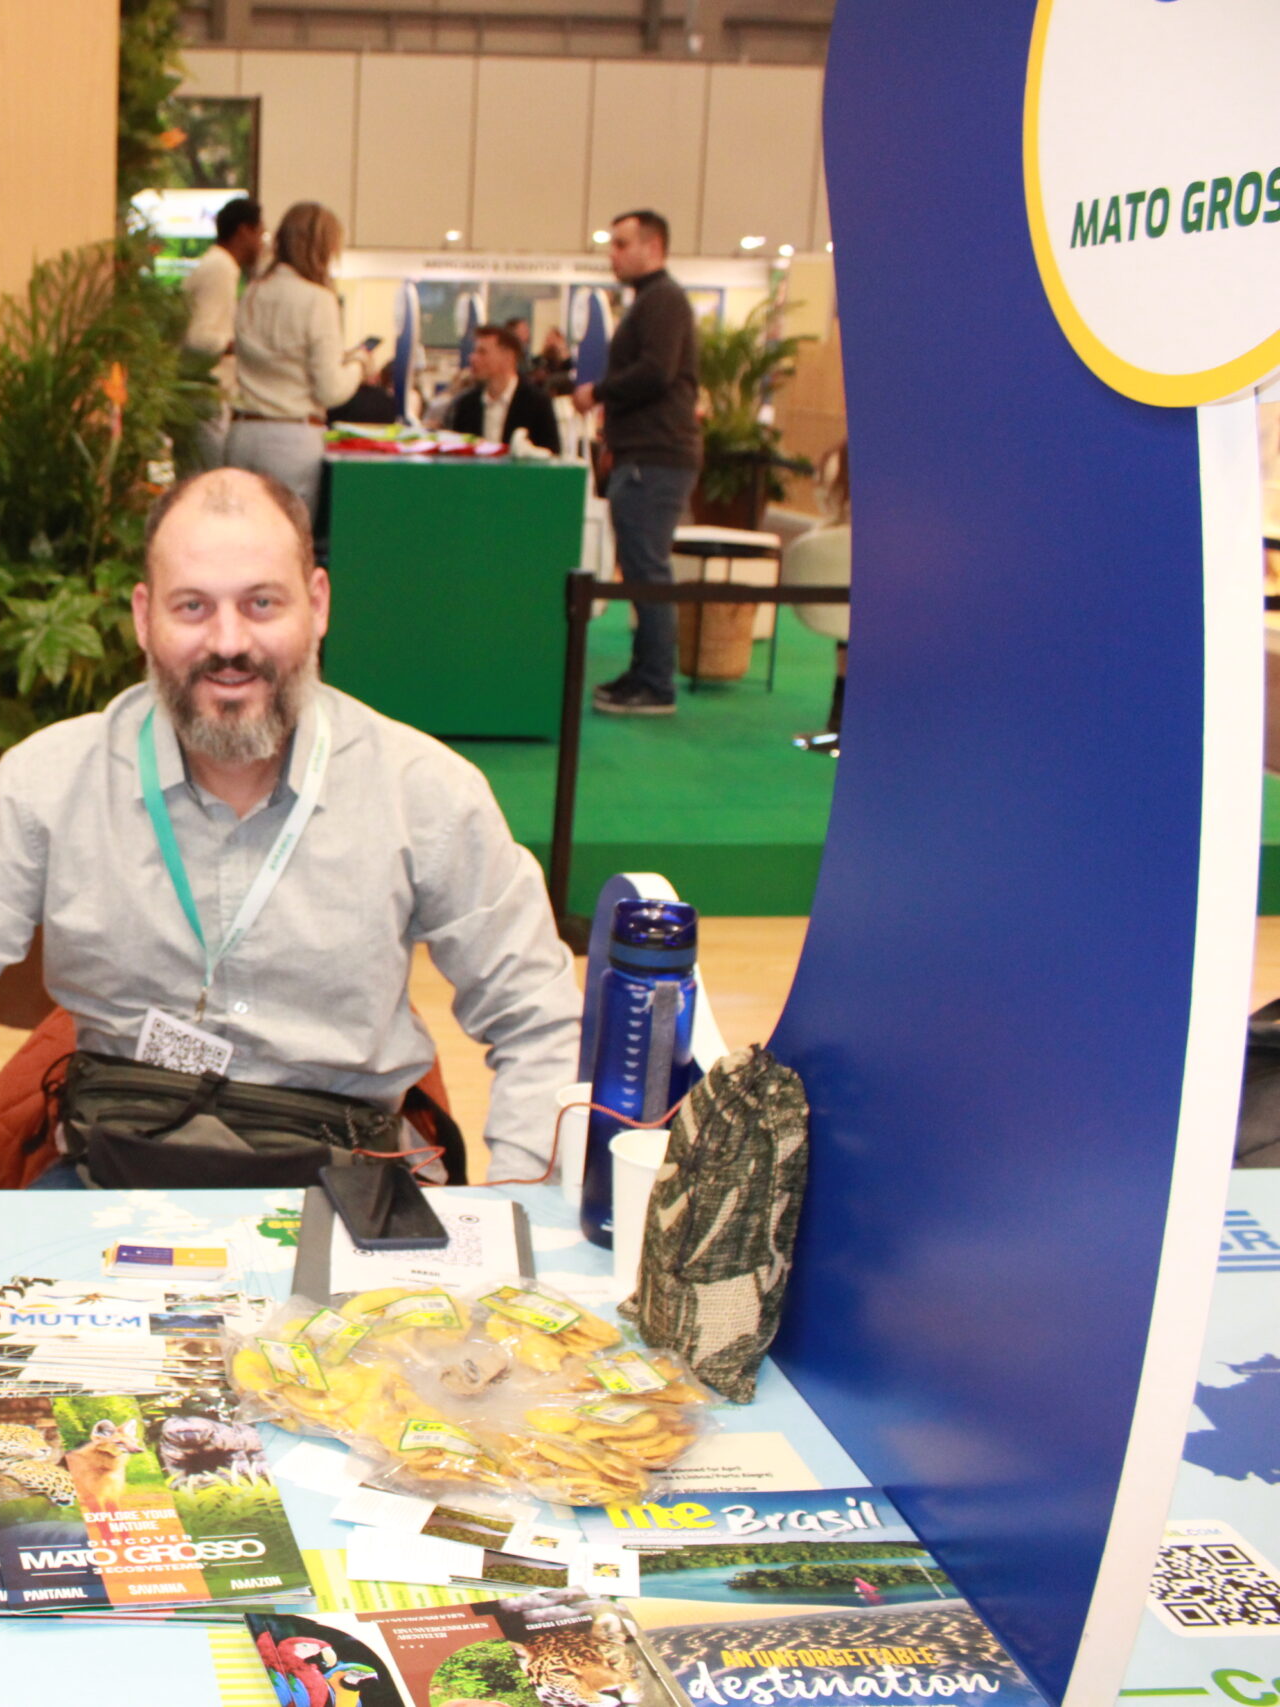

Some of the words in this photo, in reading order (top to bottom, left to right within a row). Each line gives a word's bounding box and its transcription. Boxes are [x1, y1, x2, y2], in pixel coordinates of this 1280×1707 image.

[1070, 187, 1171, 249] MATO
[83, 1511, 141, 1523] EXPLORE
[143, 1509, 179, 1521] YOUR
[721, 1497, 885, 1537] Brasil
[109, 1520, 160, 1532] NATURE
[87, 1534, 193, 1548] DISCOVER
[19, 1546, 118, 1570] MATO
[123, 1538, 267, 1564] GROSSO
[128, 1582, 187, 1595] SAVANNA
[230, 1575, 283, 1590] AMAZON
[23, 1586, 88, 1601] PANTANAL
[721, 1650, 755, 1668] AN
[755, 1647, 939, 1667] UNFORGETTABLE
[688, 1661, 1000, 1706] destination
